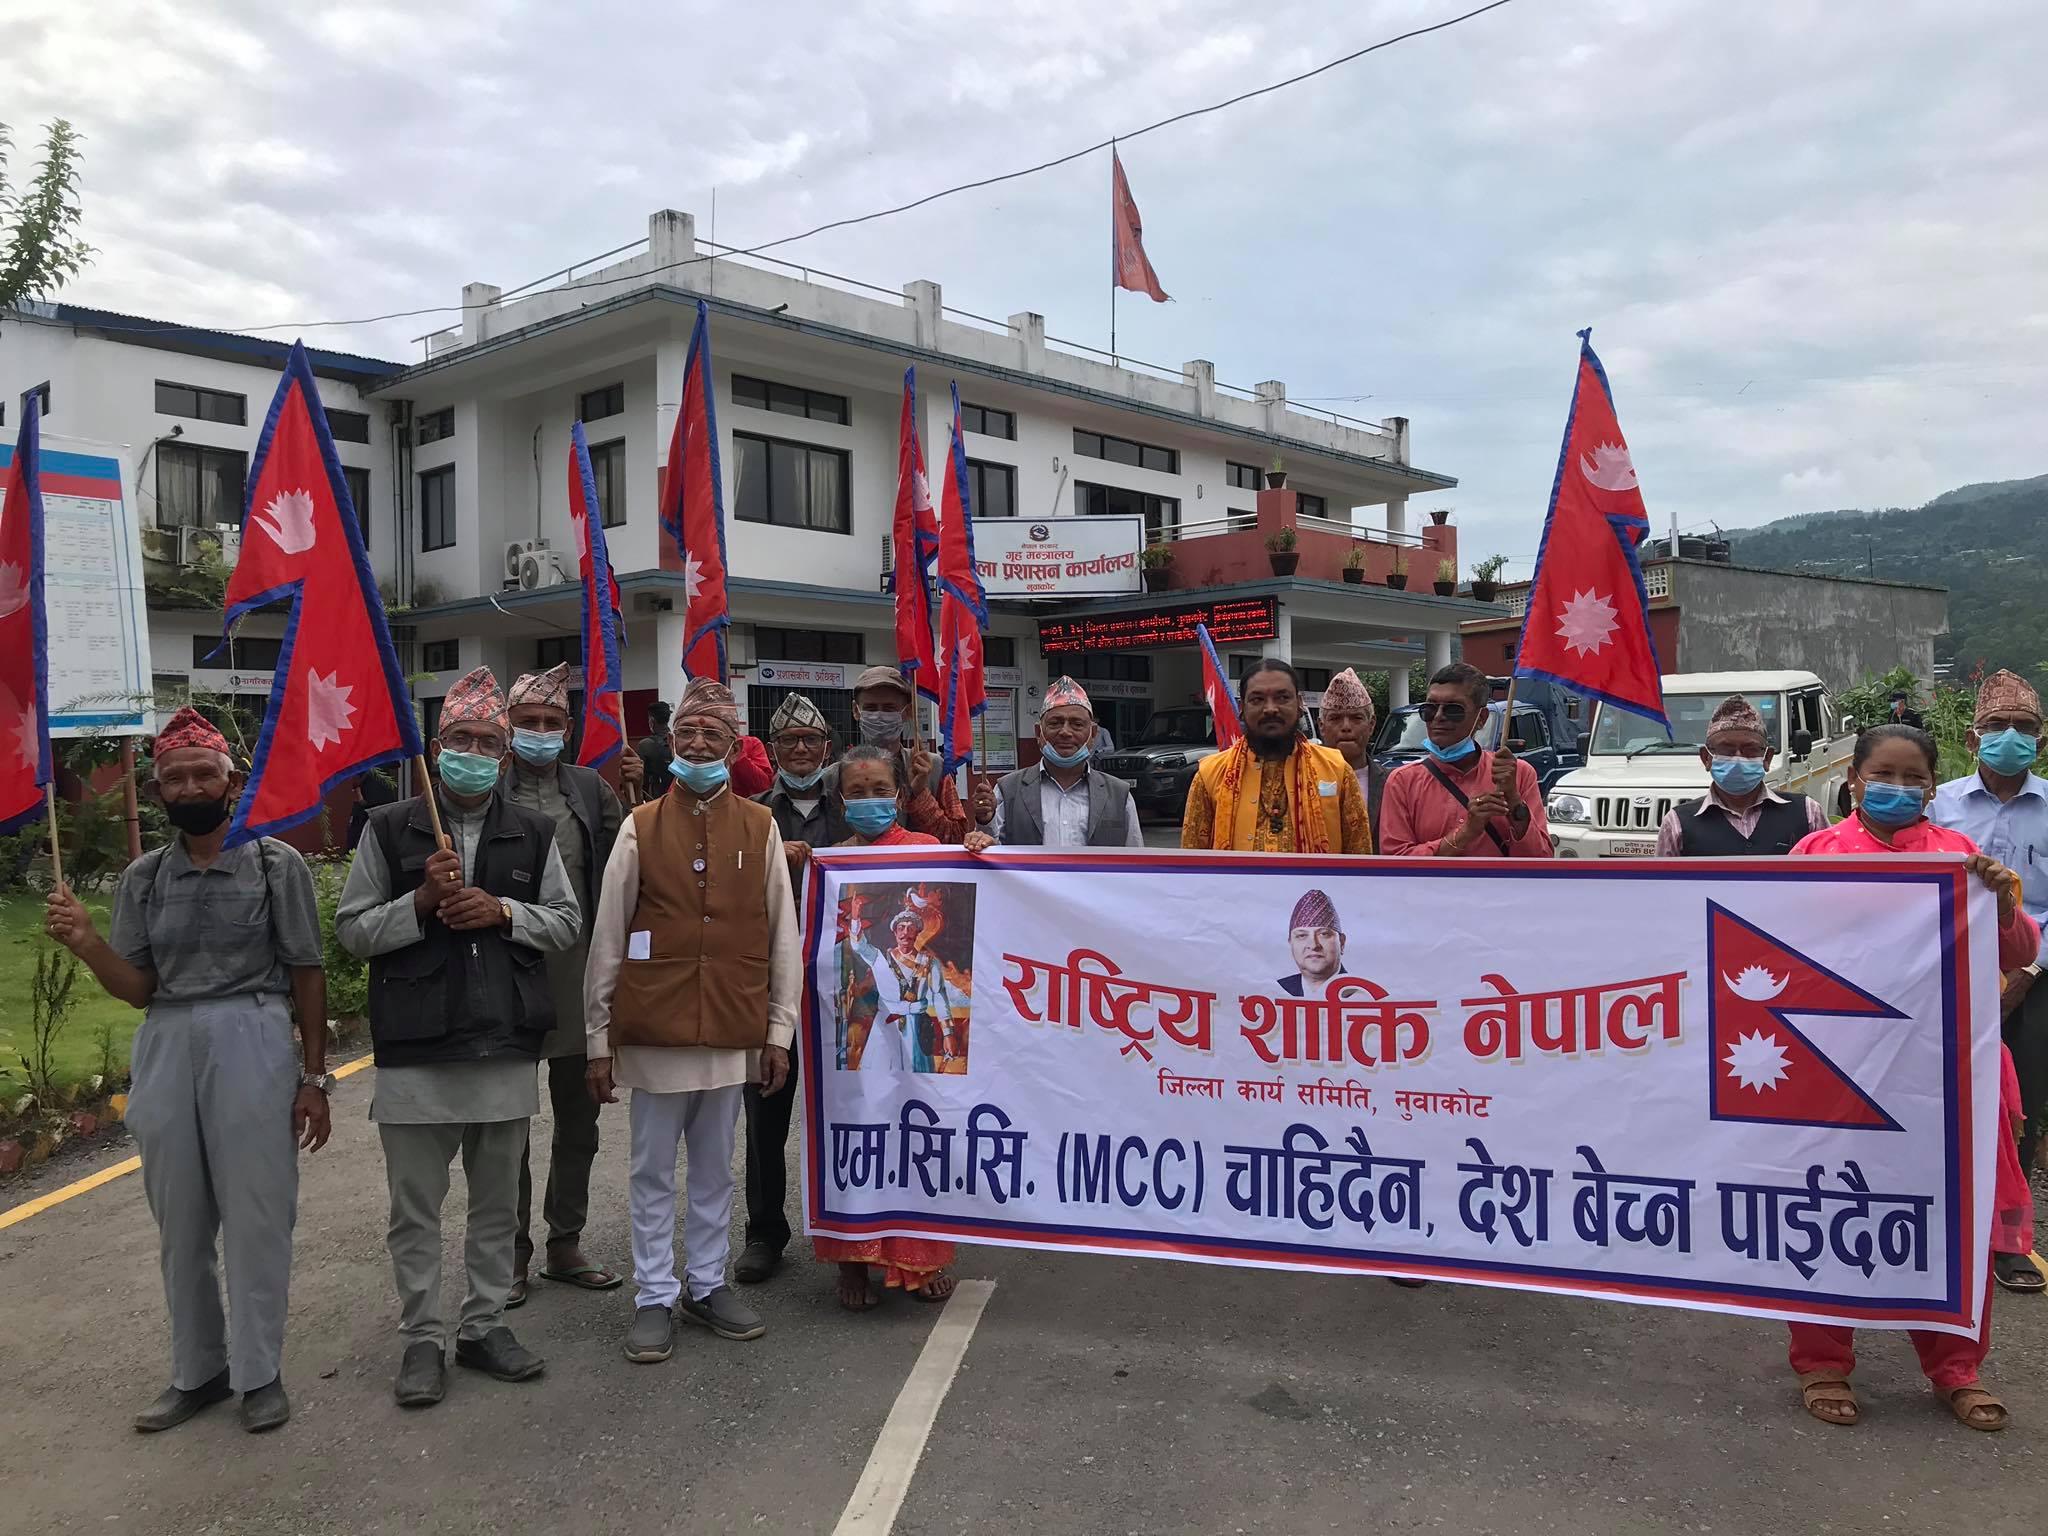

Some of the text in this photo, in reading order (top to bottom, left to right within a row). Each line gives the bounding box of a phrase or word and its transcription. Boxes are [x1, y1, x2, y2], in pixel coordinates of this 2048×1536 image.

[975, 552, 1136, 581] ला प्रशासन कार्यालय
[1006, 550, 1075, 562] गृह मन्त्रालय
[1002, 948, 1217, 1063] राष्ट्रिय
[1460, 970, 1688, 1060] नेपाल
[1156, 1067, 1493, 1122] जिल्ला कार्य समिति, नुवाकोट
[829, 1098, 1935, 1282] एम.सि.सि. (MCC) चाहिदैन, देश बेच्न पाईदैन
